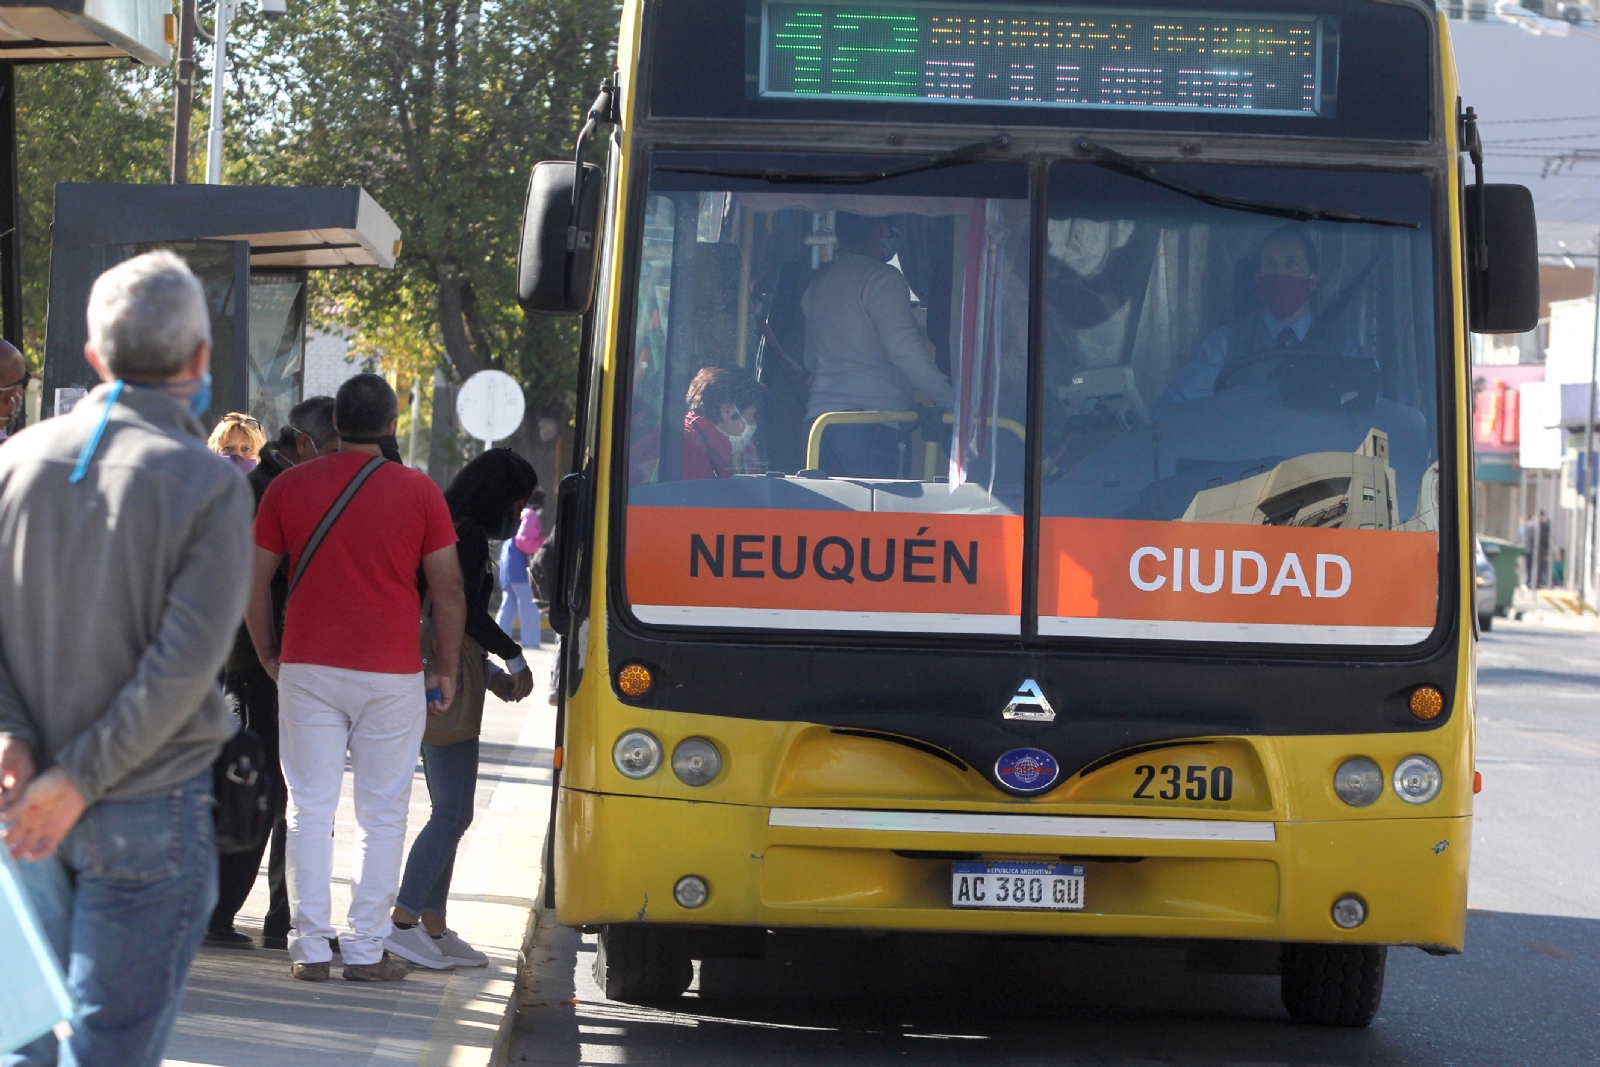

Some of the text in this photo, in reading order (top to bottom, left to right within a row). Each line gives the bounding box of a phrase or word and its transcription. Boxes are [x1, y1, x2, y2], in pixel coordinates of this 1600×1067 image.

[689, 526, 979, 585] NEUQUÉN
[1129, 546, 1352, 598] CIUDAD
[1132, 764, 1233, 802] 2350
[958, 876, 1080, 904] AC 380 GU
